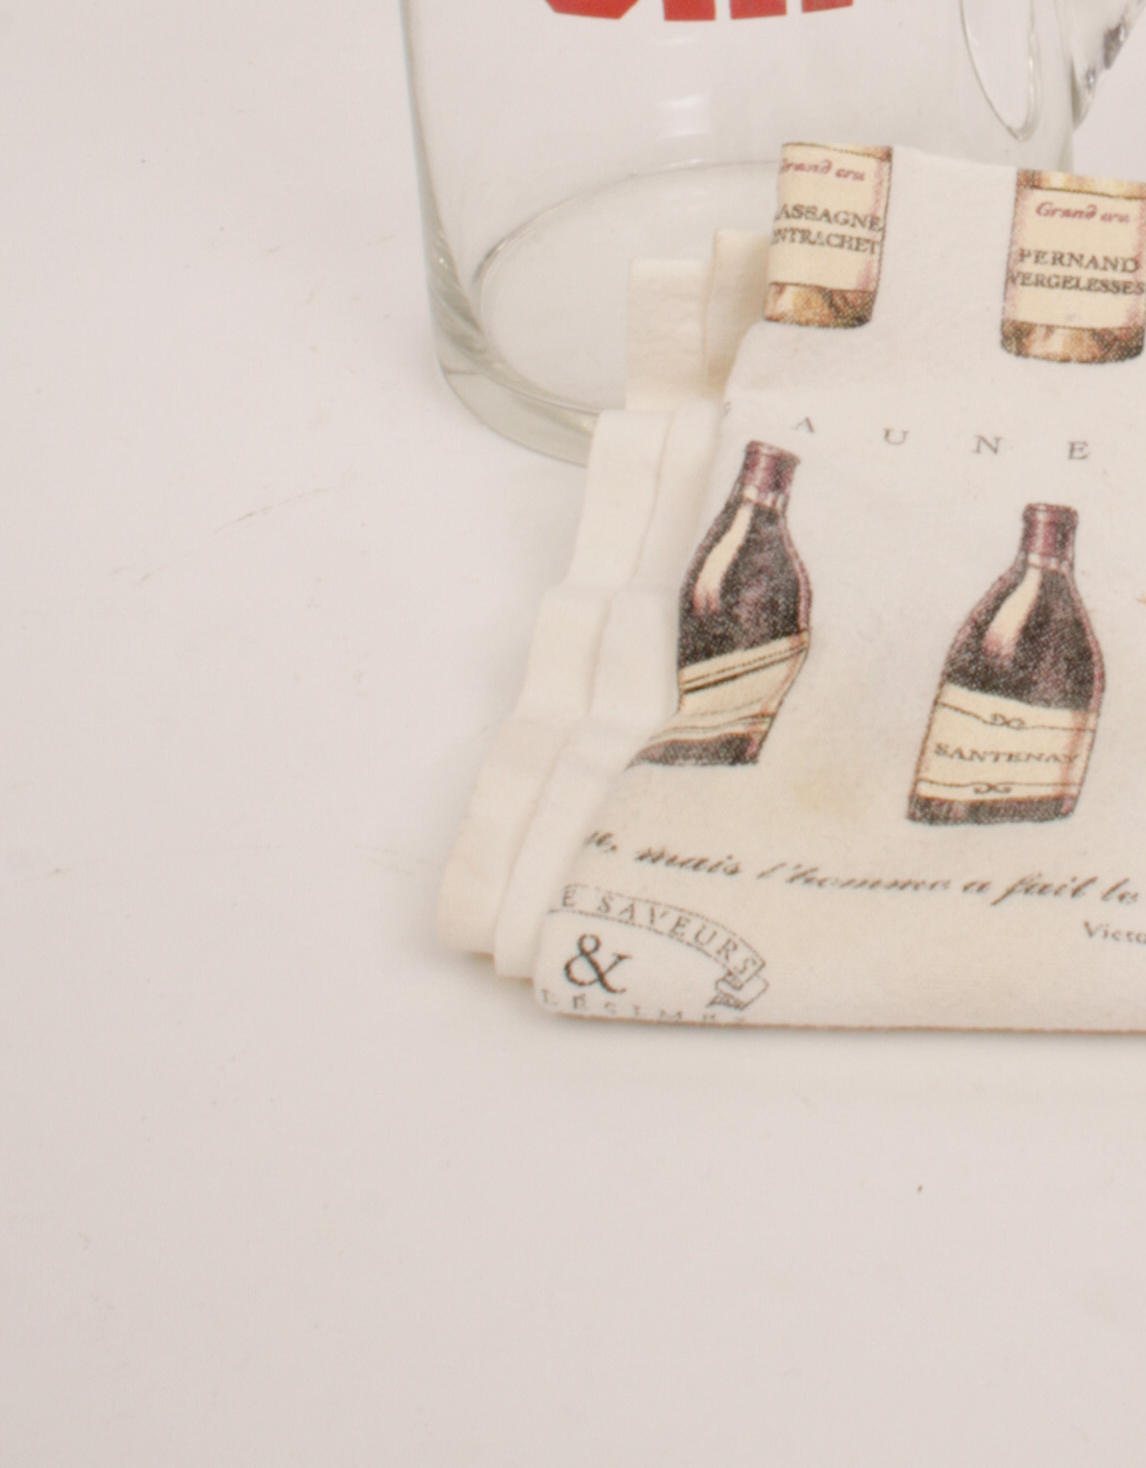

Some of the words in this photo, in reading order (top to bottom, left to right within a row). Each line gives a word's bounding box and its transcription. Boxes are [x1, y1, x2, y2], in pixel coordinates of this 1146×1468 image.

[1036, 201, 1098, 219] Grand
[1100, 212, 1131, 223] cru
[1018, 248, 1140, 273] PERNAND
[1007, 271, 1146, 295] VERGELESSES
[934, 742, 1082, 764] SANTENAY
[635, 847, 741, 875] mais
[597, 890, 760, 975] SAVEURS
[564, 934, 631, 995] &
